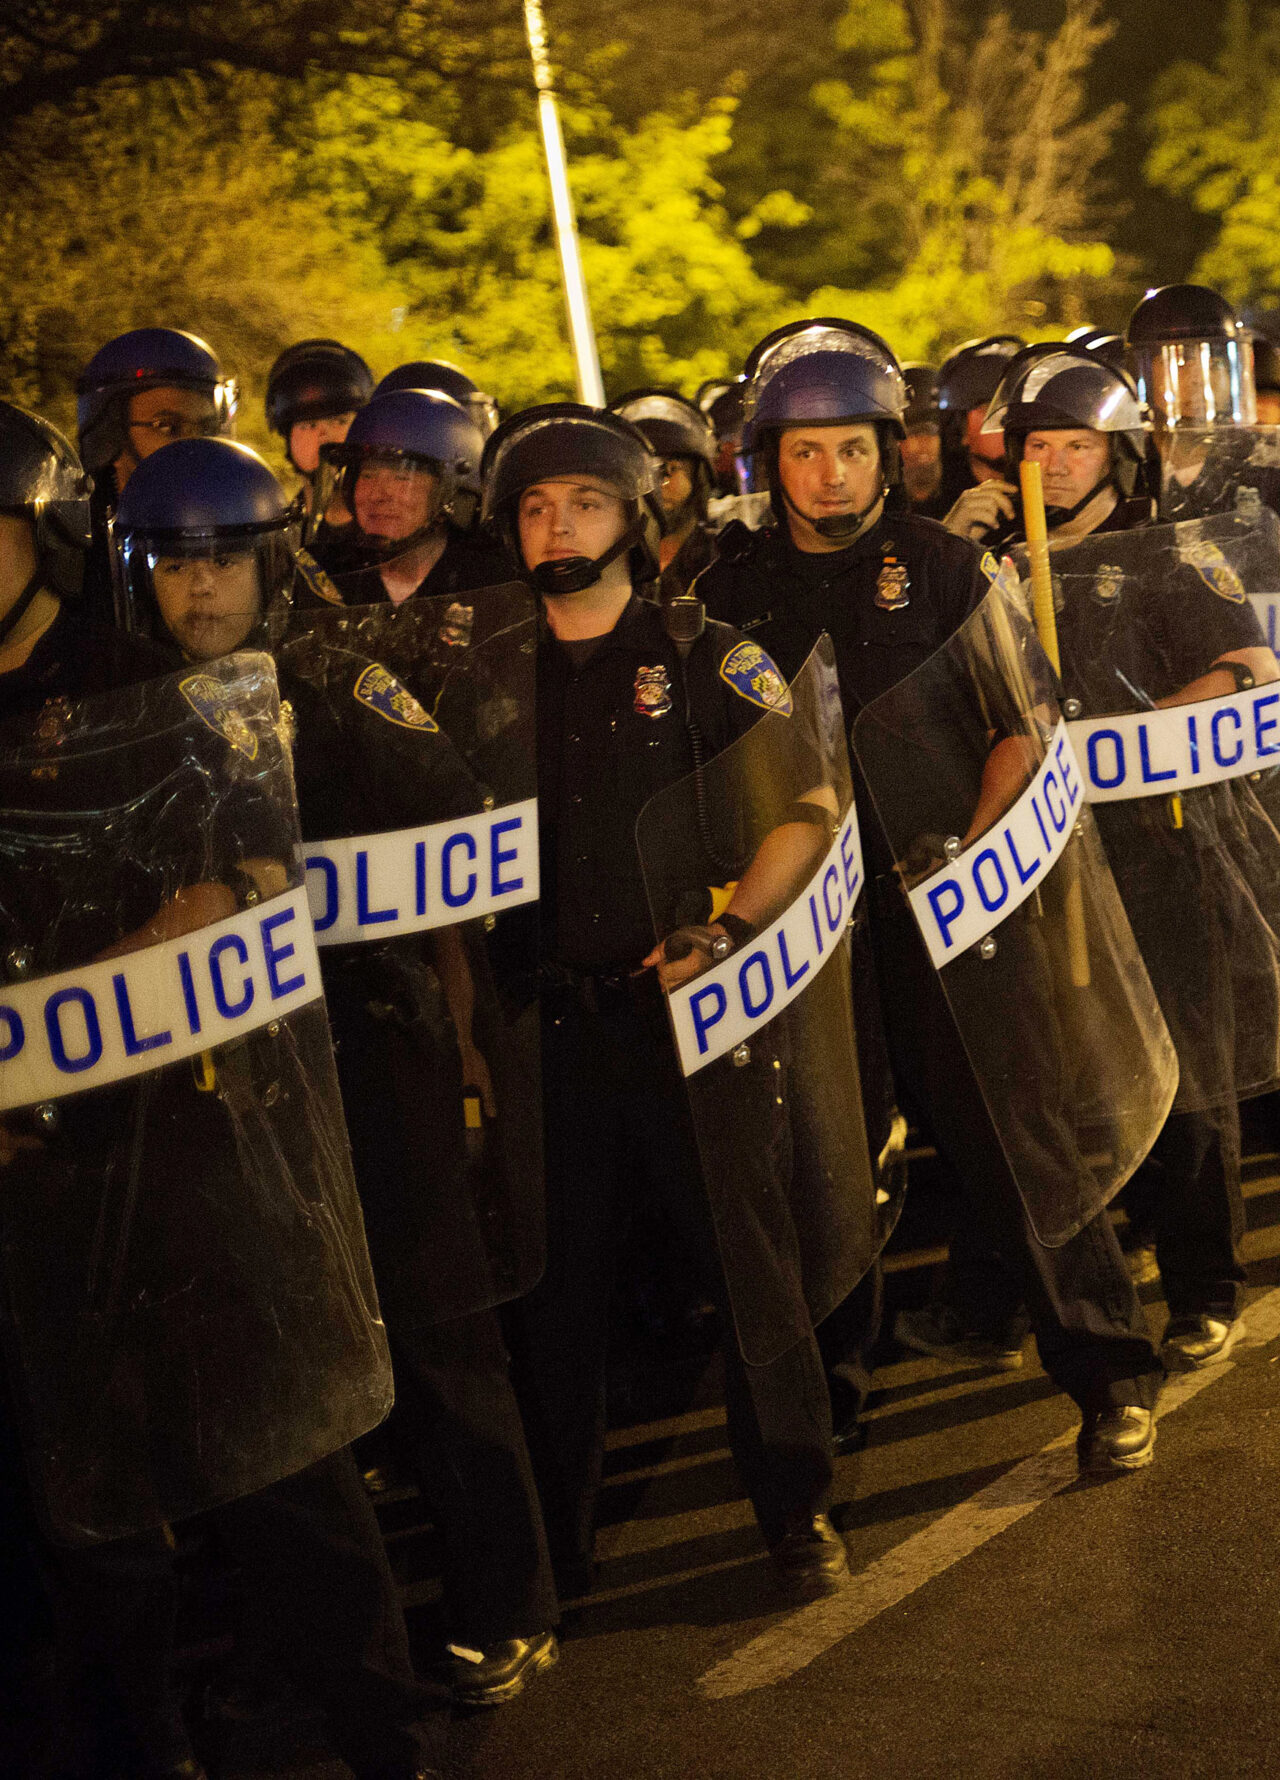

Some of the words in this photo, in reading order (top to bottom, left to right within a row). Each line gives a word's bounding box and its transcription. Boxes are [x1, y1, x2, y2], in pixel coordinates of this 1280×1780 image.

[305, 817, 523, 932] OLICE
[689, 824, 858, 1055] POLICE
[927, 738, 1078, 948] POLICE
